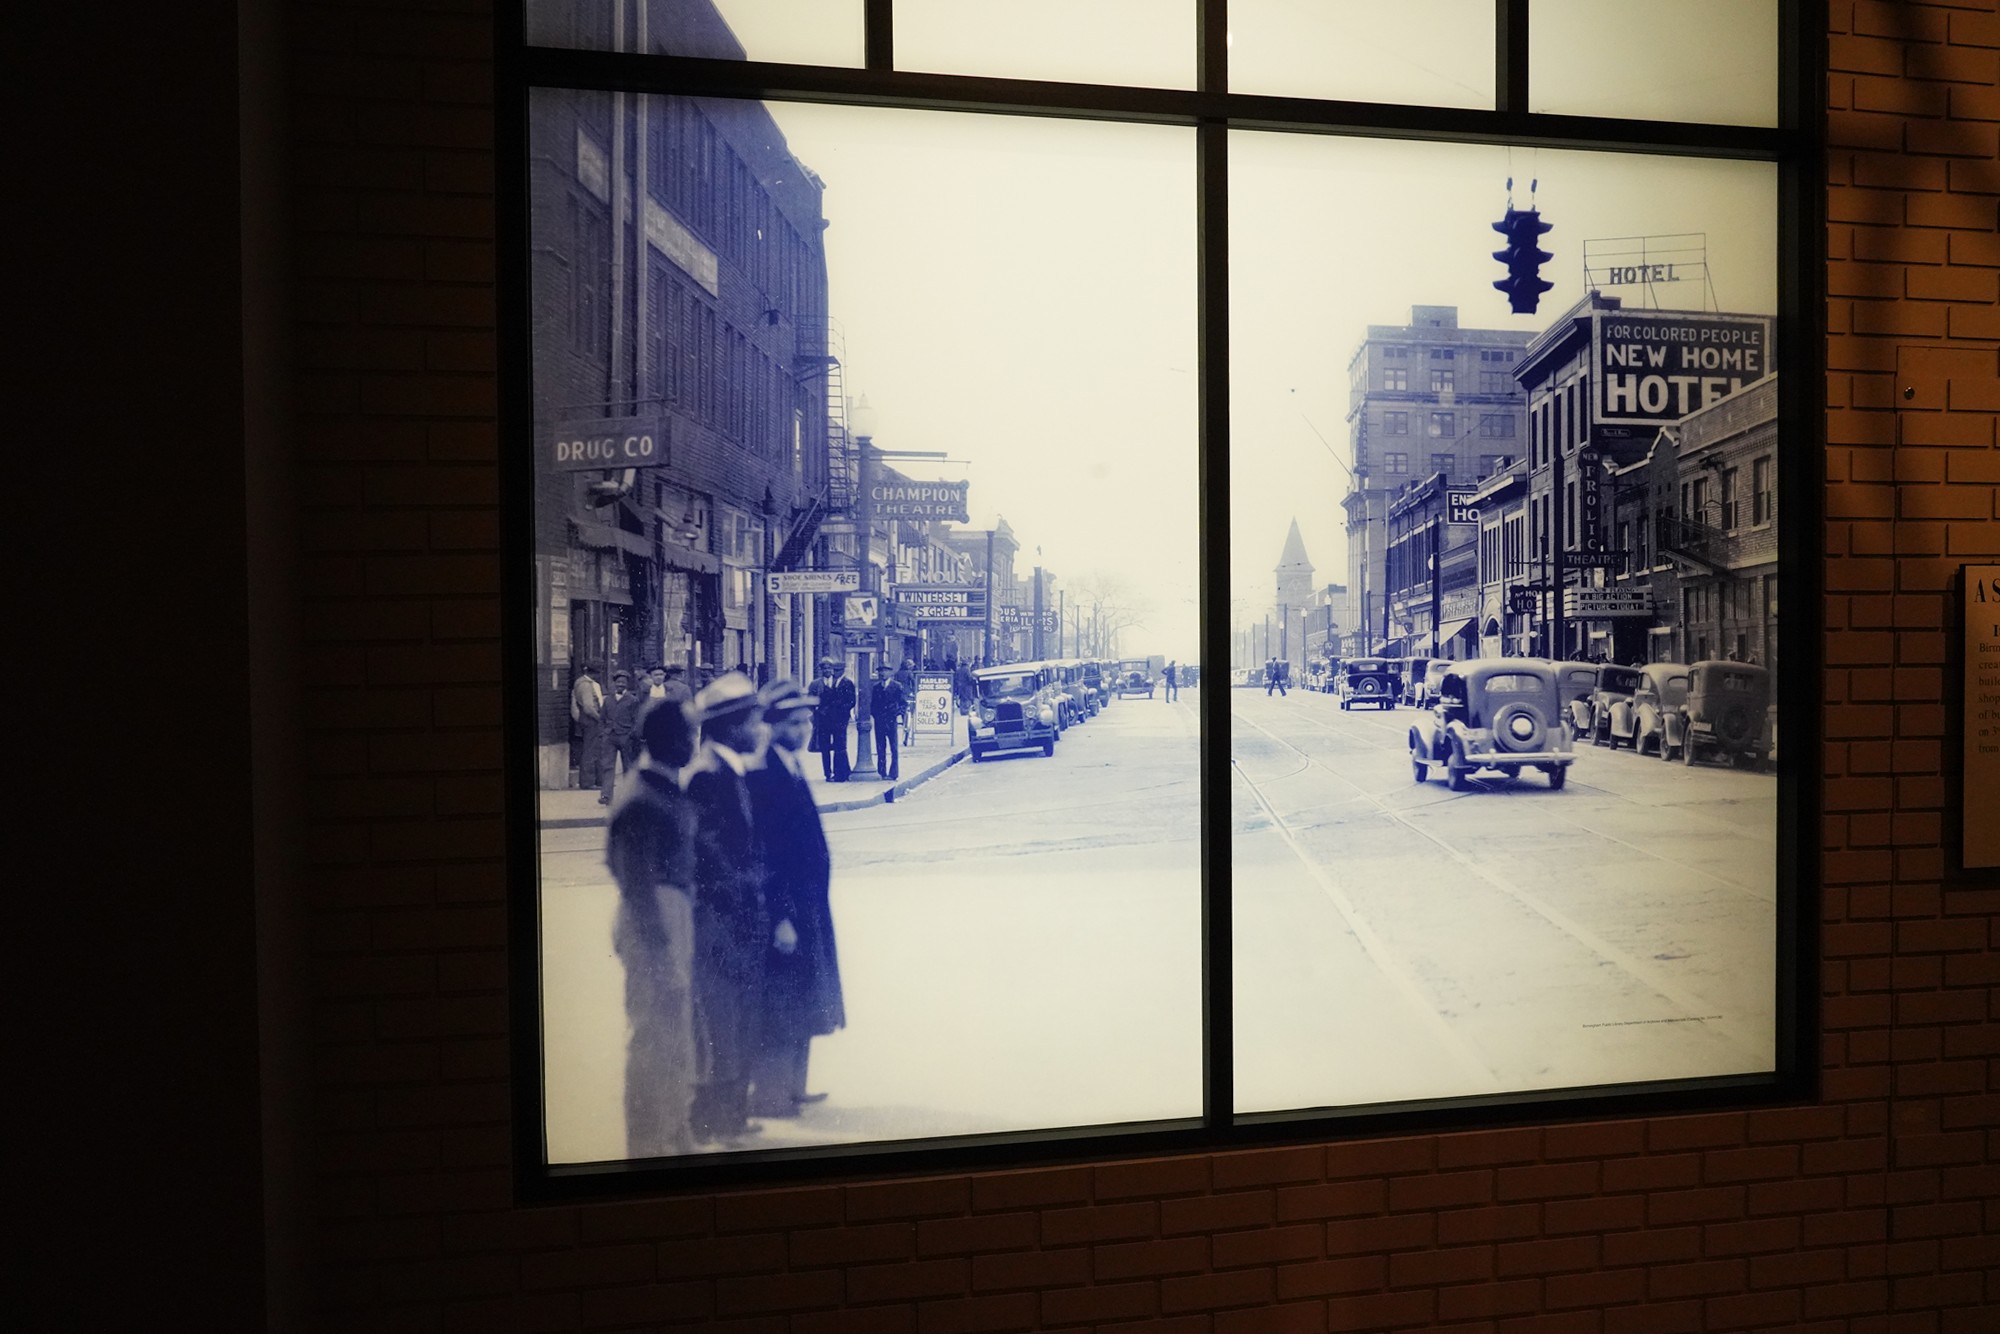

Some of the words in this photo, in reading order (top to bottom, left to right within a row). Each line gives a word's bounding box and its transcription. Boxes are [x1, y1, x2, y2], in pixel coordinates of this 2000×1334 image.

[1610, 264, 1680, 284] HOTEL
[1606, 325, 1631, 339] FOR
[1634, 327, 1697, 341] COLORED
[1701, 329, 1761, 344] PEOPLE
[1606, 344, 1667, 368] NEW
[1681, 346, 1759, 371] HOME
[557, 438, 615, 461] DRUG
[624, 435, 653, 457] CO
[871, 486, 960, 502] CHAMPION
[873, 503, 957, 515] THEATRE
[1586, 465, 1597, 550] FROLIC
[1454, 508, 1480, 521] HO
[1567, 554, 1617, 565] THEATRE
[771, 577, 780, 590] 5
[834, 573, 857, 585] FREE
[1973, 578, 1986, 603] A
[904, 592, 966, 603] WINTERSET
[1517, 599, 1533, 609] HO
[928, 606, 964, 617] GREAT
[1978, 661, 2000, 669] crea
[938, 696, 947, 710] 9
[1978, 709, 1989, 719] of
[1978, 727, 1989, 736] on
[1978, 743, 1999, 752] from
